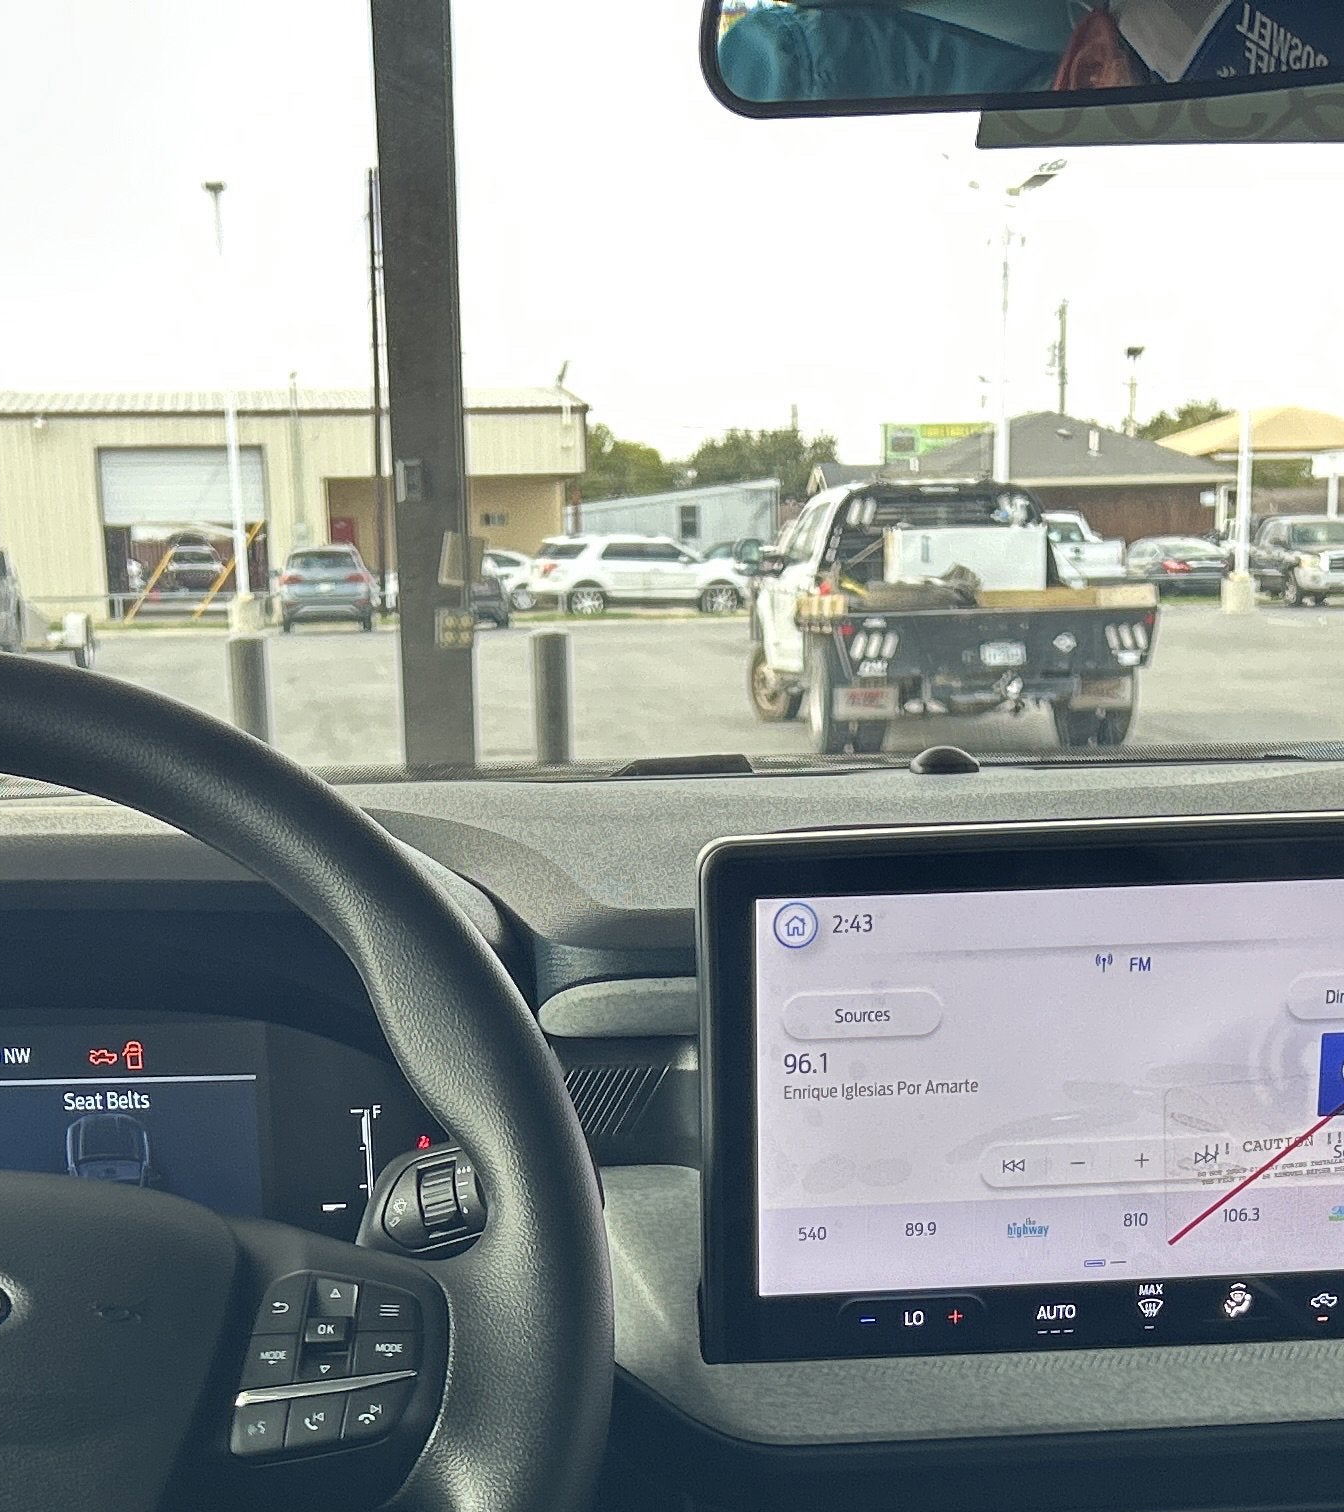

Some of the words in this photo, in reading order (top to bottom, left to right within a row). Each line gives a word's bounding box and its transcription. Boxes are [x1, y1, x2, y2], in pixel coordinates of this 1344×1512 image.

[832, 914, 873, 934] 2:43
[1129, 957, 1151, 972] FM
[834, 1009, 891, 1024] Sources
[3, 1047, 31, 1064] NW
[783, 1053, 828, 1074] 96.1
[783, 1084, 838, 1101] Enrique
[841, 1082, 893, 1100] Iglesias
[897, 1081, 921, 1095] Por
[925, 1079, 979, 1094] Amarte
[63, 1091, 103, 1111] Seat
[107, 1090, 150, 1110] Belts
[372, 1104, 381, 1119] F
[1242, 1135, 1313, 1152] CAUTION
[1123, 1213, 1149, 1228] 810
[1223, 1208, 1260, 1222] 106.3
[798, 1226, 827, 1241] 540
[905, 1221, 937, 1237] 89.9
[1008, 1222, 1049, 1238] highway
[1139, 1284, 1163, 1295] MAX
[904, 1311, 924, 1326] LO
[1036, 1305, 1076, 1320] AUTO
[317, 1324, 335, 1335] OK
[260, 1350, 287, 1360] MODE
[375, 1343, 403, 1353] MODE
